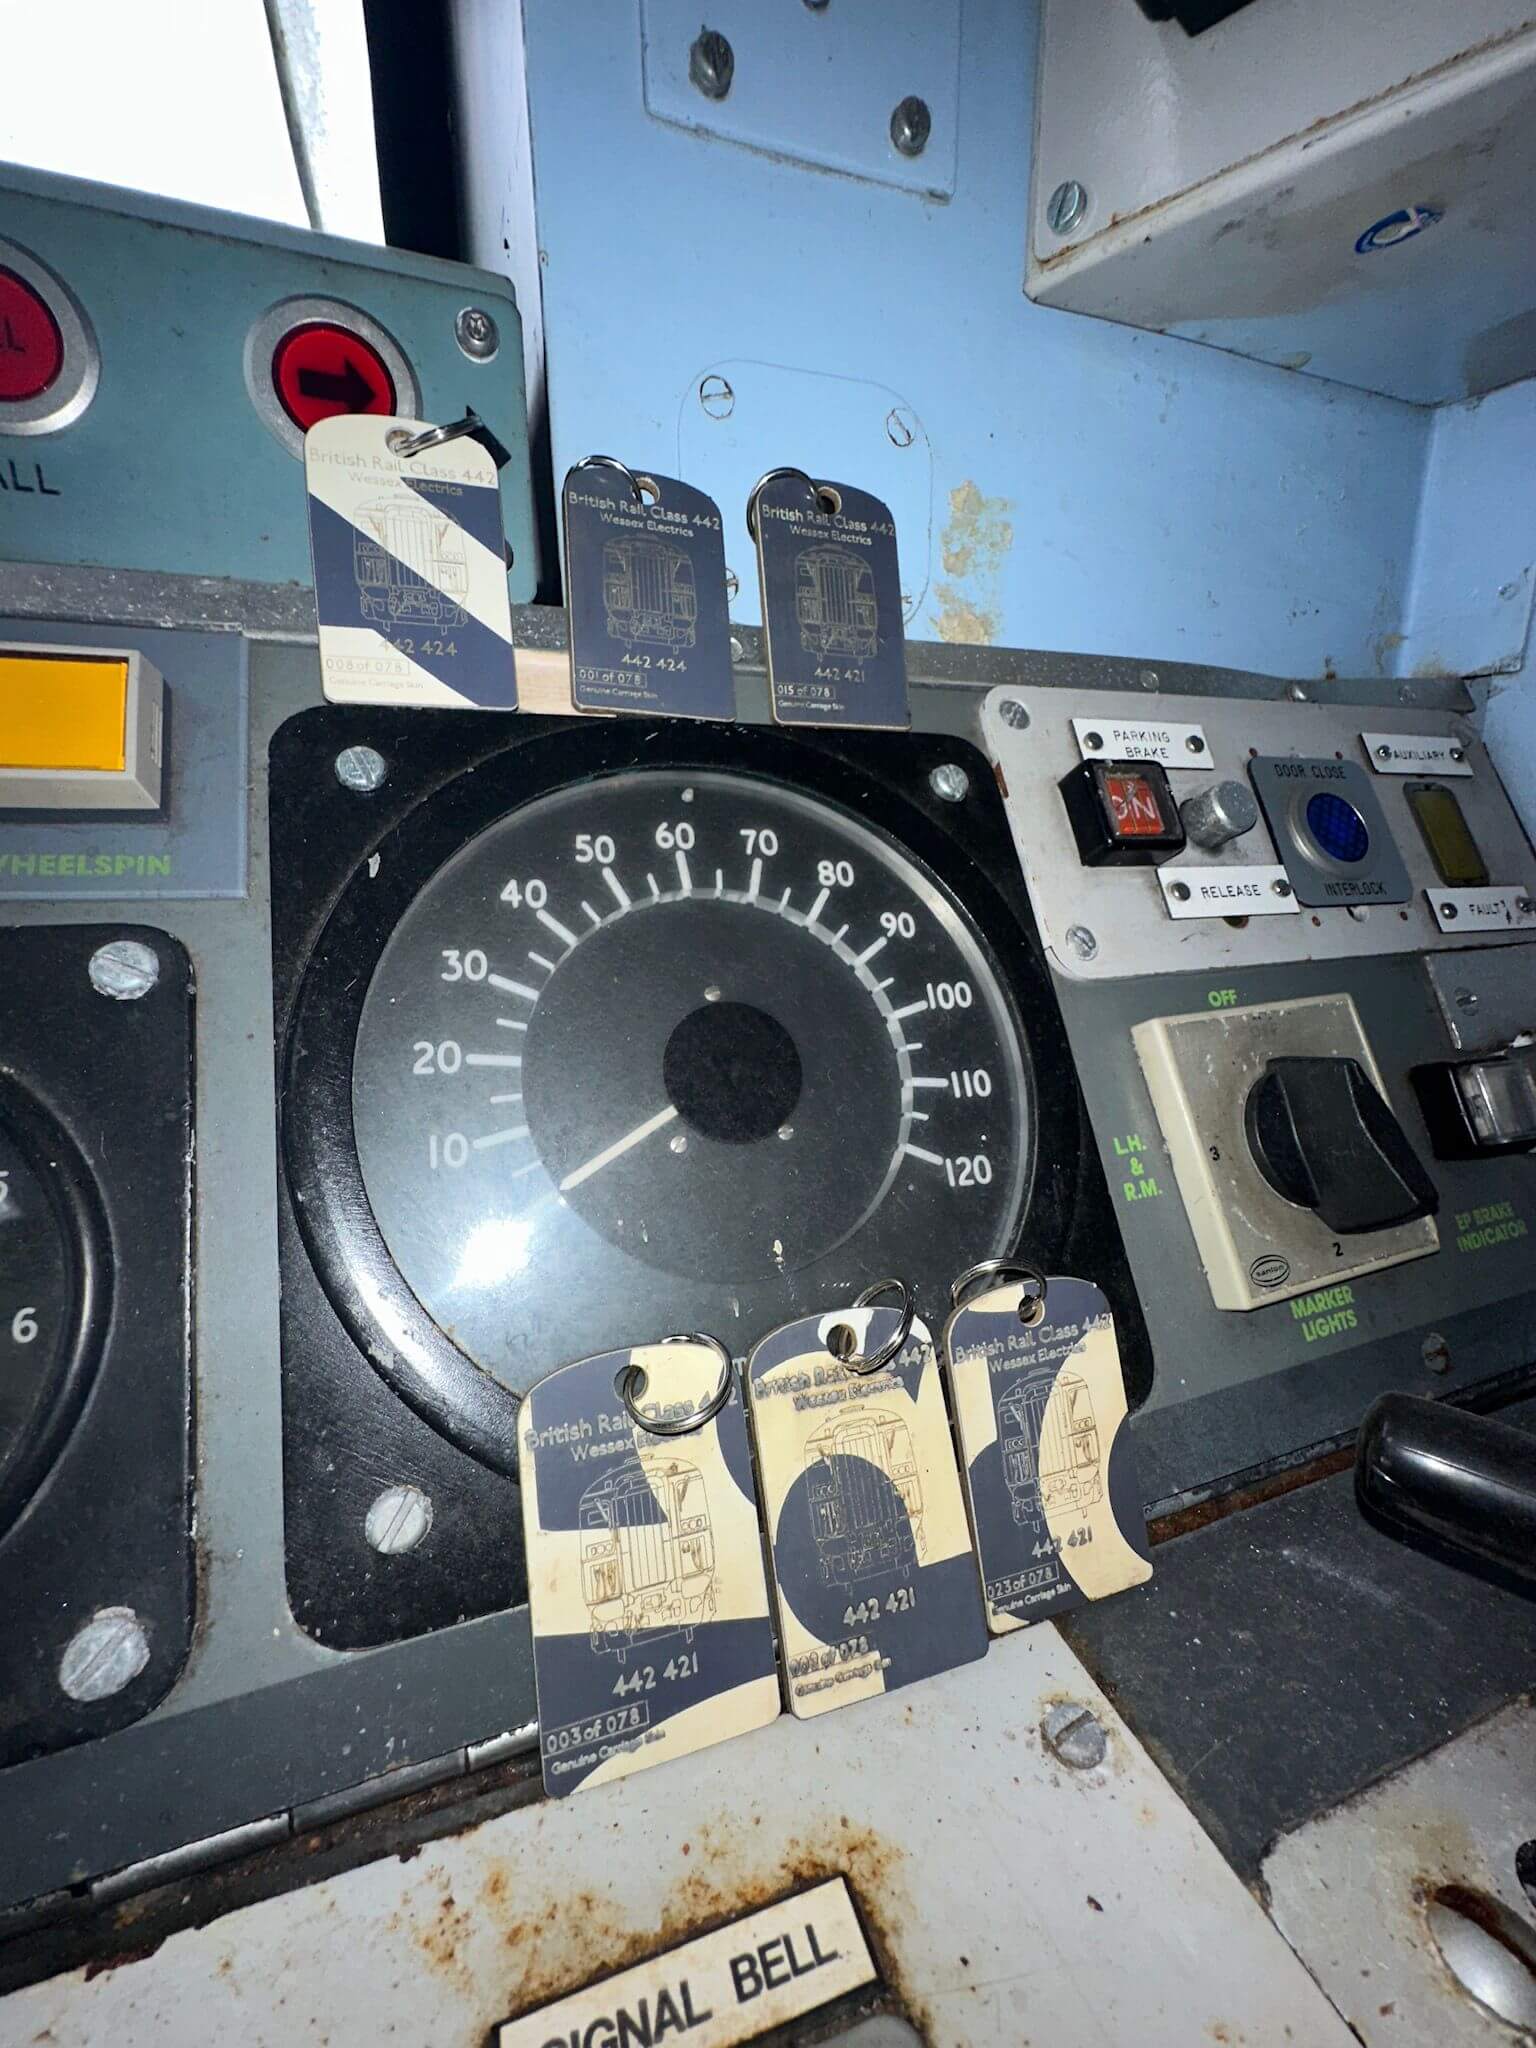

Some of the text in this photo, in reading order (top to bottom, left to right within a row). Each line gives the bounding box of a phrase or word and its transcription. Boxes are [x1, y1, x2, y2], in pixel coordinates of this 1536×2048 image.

[310, 447, 496, 485] British Rail Class 442
[406, 480, 463, 496] Electrics
[568, 491, 720, 530] British Rail Class 442
[600, 511, 694, 537] Wessex Electrics
[762, 504, 895, 537] British Rail Class 442
[790, 523, 873, 546] Wessex Electrics
[421, 639, 458, 656] 424
[621, 653, 688, 672] 442 424
[814, 667, 865, 683] 442 421
[602, 671, 614, 683] of
[617, 673, 642, 686] 078
[777, 685, 831, 698] 015 of 078
[1112, 730, 1171, 744] PARKING
[1125, 746, 1170, 759] BRAKE
[1393, 750, 1445, 762] AUXILIARY
[1273, 763, 1348, 780] DOOR CLOSE
[1111, 795, 1156, 820] ON
[575, 834, 616, 865] 50
[655, 822, 696, 850] 60
[739, 829, 779, 857] 70
[817, 860, 855, 888] 80
[500, 878, 548, 909] 40
[1200, 884, 1262, 900] RELEASE
[1323, 881, 1388, 897] INTERLOCK
[880, 911, 916, 939] 90
[440, 949, 488, 982] 30
[926, 981, 973, 1010] 100
[1208, 989, 1238, 1008] OFF
[412, 1040, 462, 1075] 20
[951, 1069, 992, 1099] 110
[429, 1132, 469, 1170] 10
[1113, 1134, 1148, 1156] L.H.
[1209, 1145, 1220, 1161] 3
[945, 1154, 993, 1188] 120
[1130, 1156, 1145, 1176] &
[1123, 1178, 1163, 1202] R.M.
[1332, 1241, 1344, 1257] 2
[1456, 1219, 1529, 1252] INDICATOR
[1290, 1285, 1354, 1319] MARKER
[12, 1306, 39, 1344] 6
[955, 1313, 1113, 1363] British Rail Class 442
[1301, 1309, 1358, 1342] LIGHTS
[901, 1343, 933, 1368] 442
[988, 1341, 1087, 1374] Wessex Electrics
[524, 1416, 593, 1451] British
[597, 1408, 638, 1435] Rail
[571, 1438, 635, 1463] Wessex
[1031, 1525, 1093, 1559] 442 421
[987, 1567, 1053, 1599] 023 of 078
[843, 1586, 916, 1627] 442 421
[612, 1651, 699, 1697] 442 421
[546, 1707, 641, 1753] 003 of 078
[541, 1924, 840, 2048] GNAL BELL
